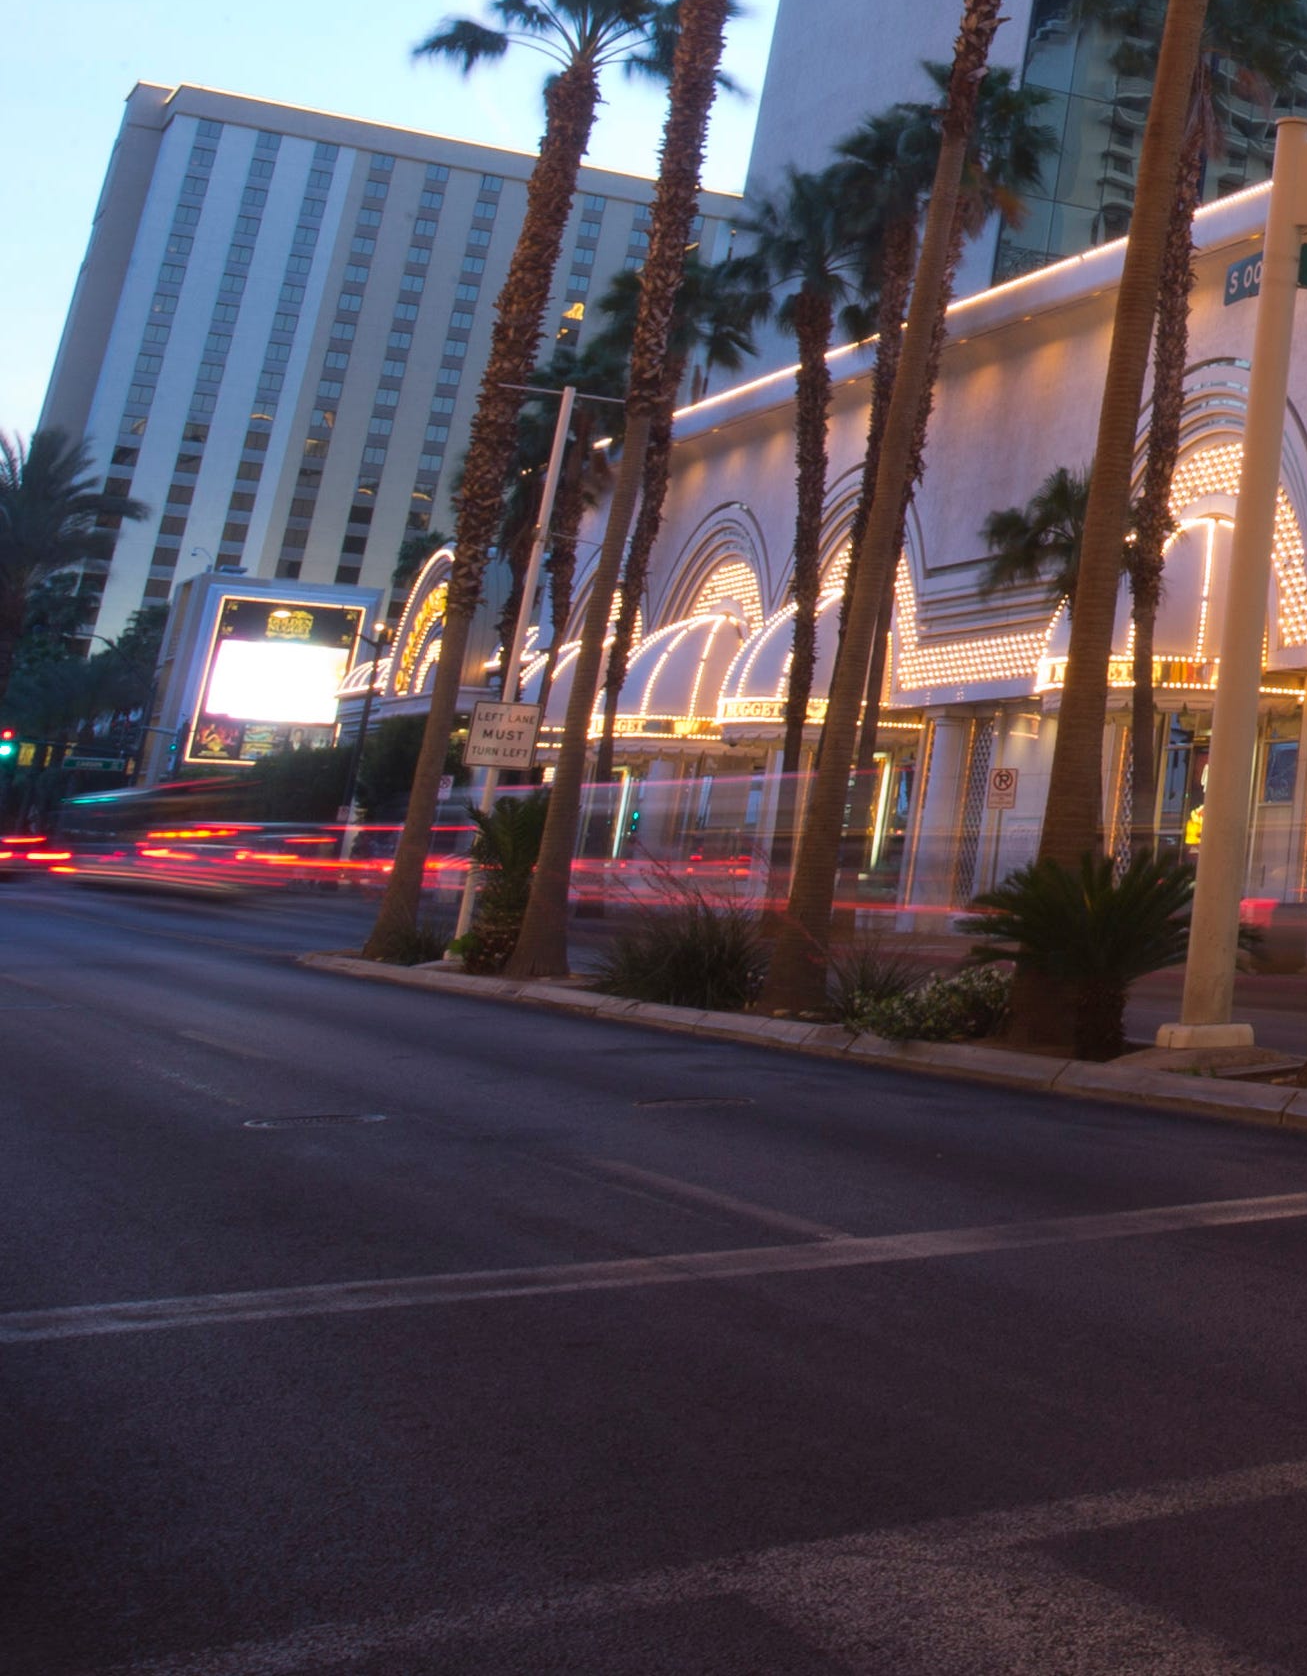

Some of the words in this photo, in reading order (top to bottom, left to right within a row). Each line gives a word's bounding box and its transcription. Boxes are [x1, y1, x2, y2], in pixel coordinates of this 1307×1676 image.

[1229, 271, 1239, 295] S
[477, 711, 504, 722] LEFT
[508, 714, 536, 725] LANE
[482, 728, 525, 741] MUST
[471, 745, 499, 757] TURN
[503, 747, 528, 758] LEFT
